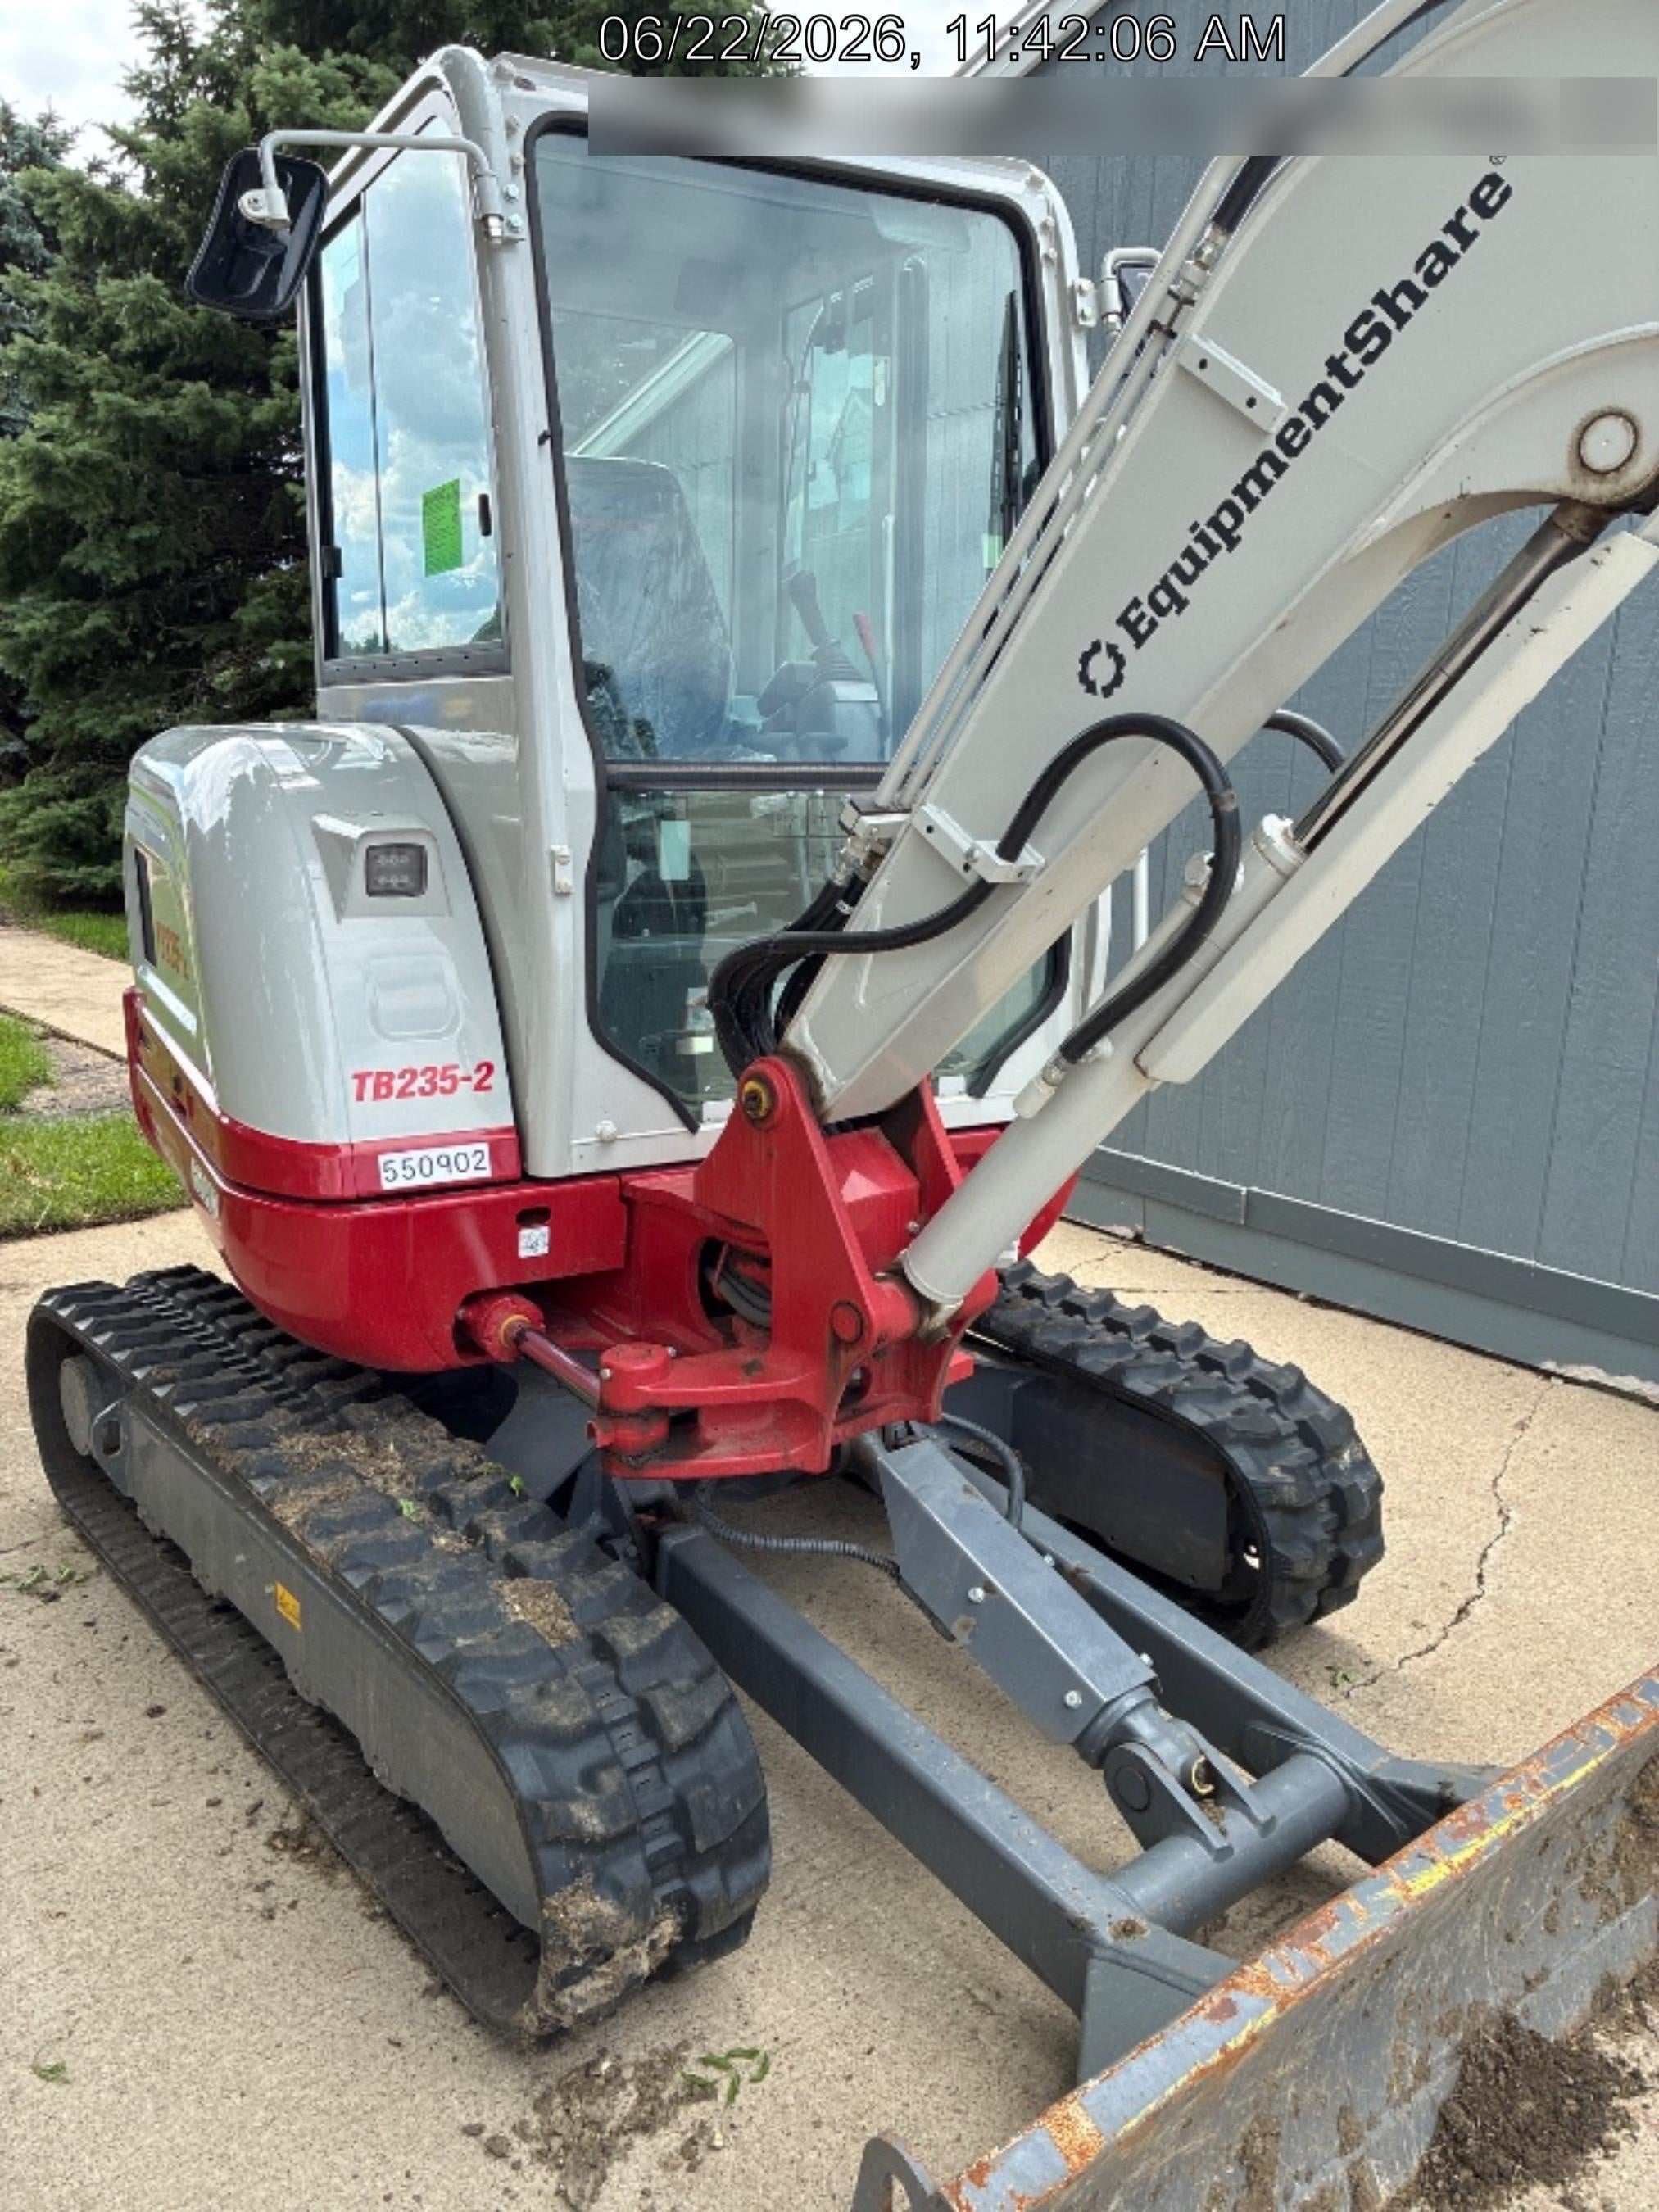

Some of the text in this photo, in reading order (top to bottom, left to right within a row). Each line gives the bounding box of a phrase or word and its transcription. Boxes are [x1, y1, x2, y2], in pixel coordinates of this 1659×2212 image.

[1115, 171, 1513, 649] EquipmentShare
[351, 1061, 495, 1101] TB235-2
[383, 1149, 487, 1182] 550902
